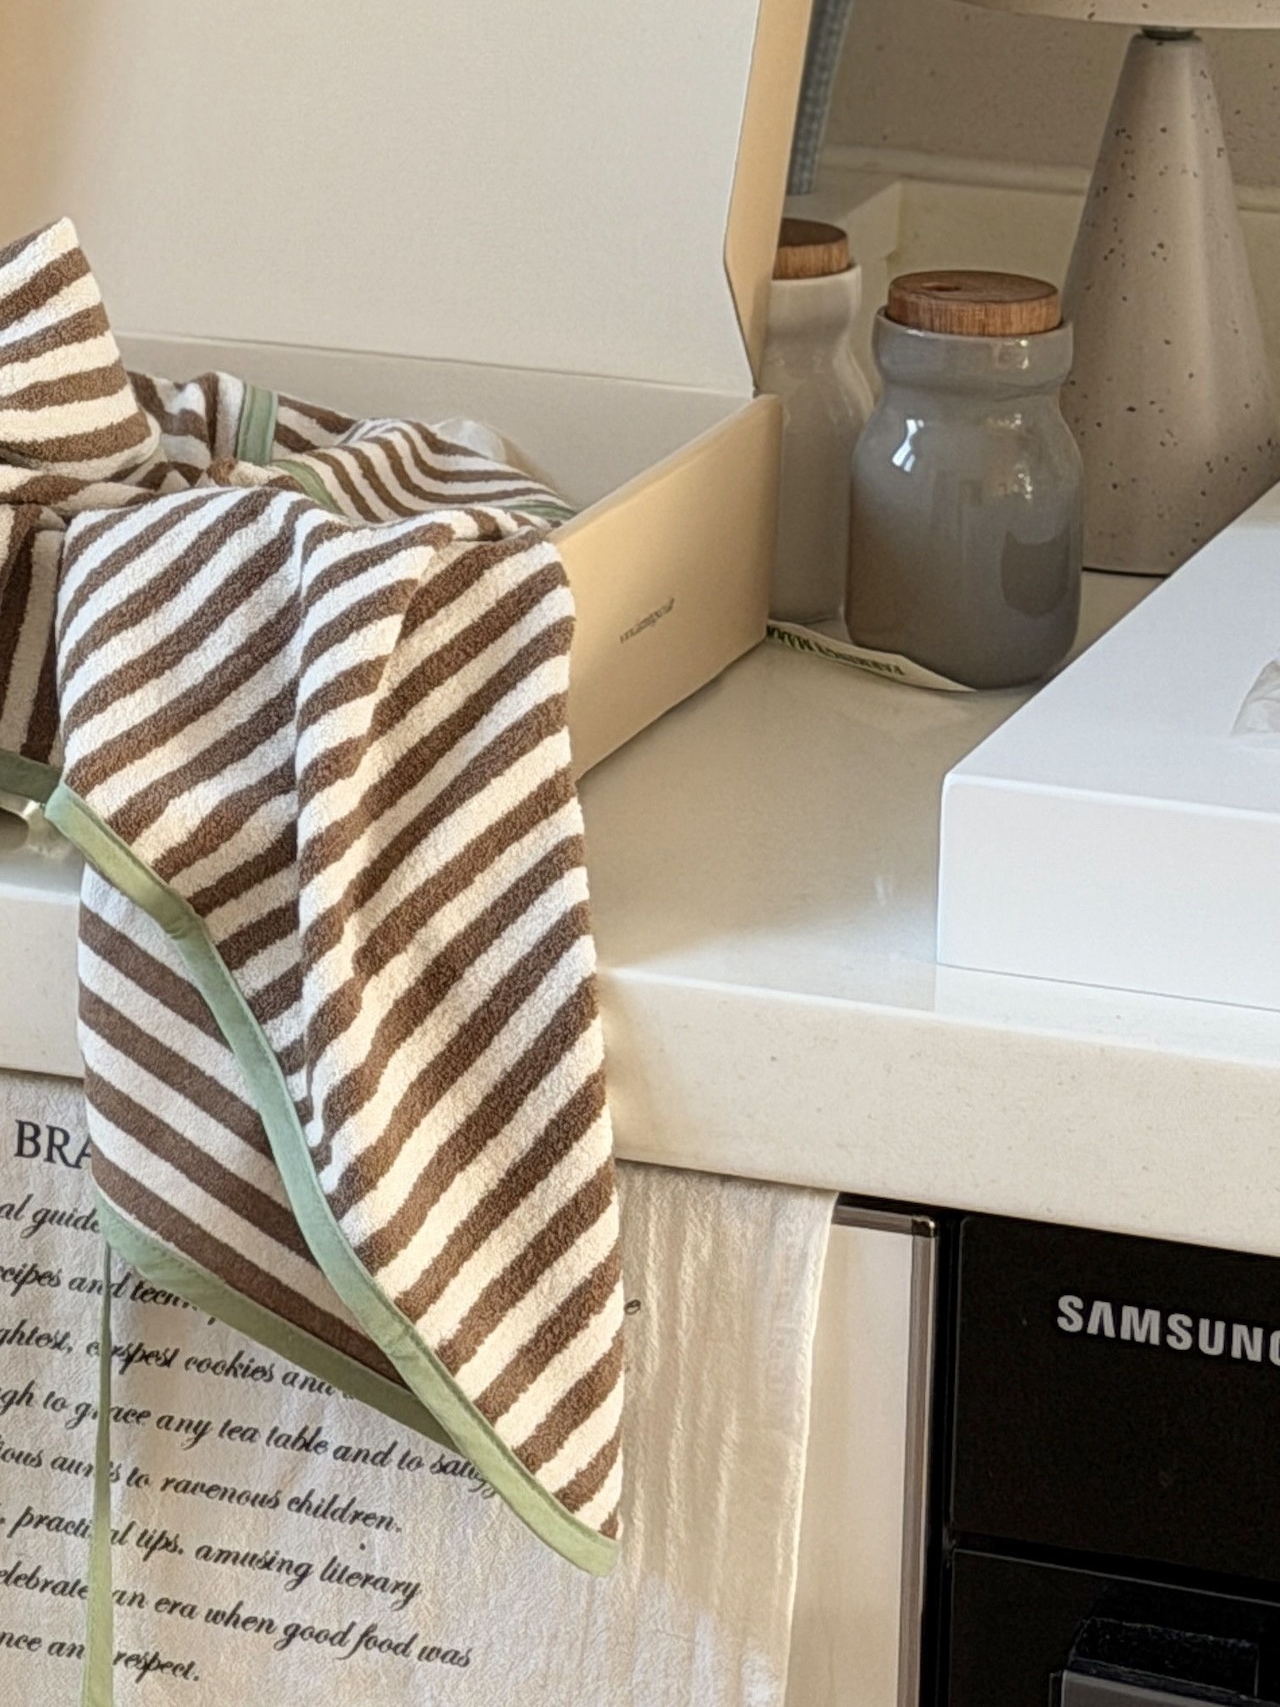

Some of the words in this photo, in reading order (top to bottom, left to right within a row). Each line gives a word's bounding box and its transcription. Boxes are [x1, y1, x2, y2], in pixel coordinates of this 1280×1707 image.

[183, 1349, 275, 1383] cookies
[42, 1390, 68, 1413] to
[155, 1414, 212, 1451] any
[217, 1418, 260, 1444] tea
[265, 1424, 329, 1455] table
[332, 1440, 399, 1468] and
[396, 1448, 425, 1472] to
[126, 1466, 150, 1489] to
[160, 1477, 282, 1510] ravenous
[195, 1544, 313, 1592] amusing
[319, 1555, 421, 1611] literary
[47, 1641, 86, 1660] an
[154, 1597, 198, 1620] era
[204, 1600, 276, 1635] when
[273, 1621, 357, 1652] good
[333, 1622, 419, 1661] food
[417, 1646, 472, 1668] was
